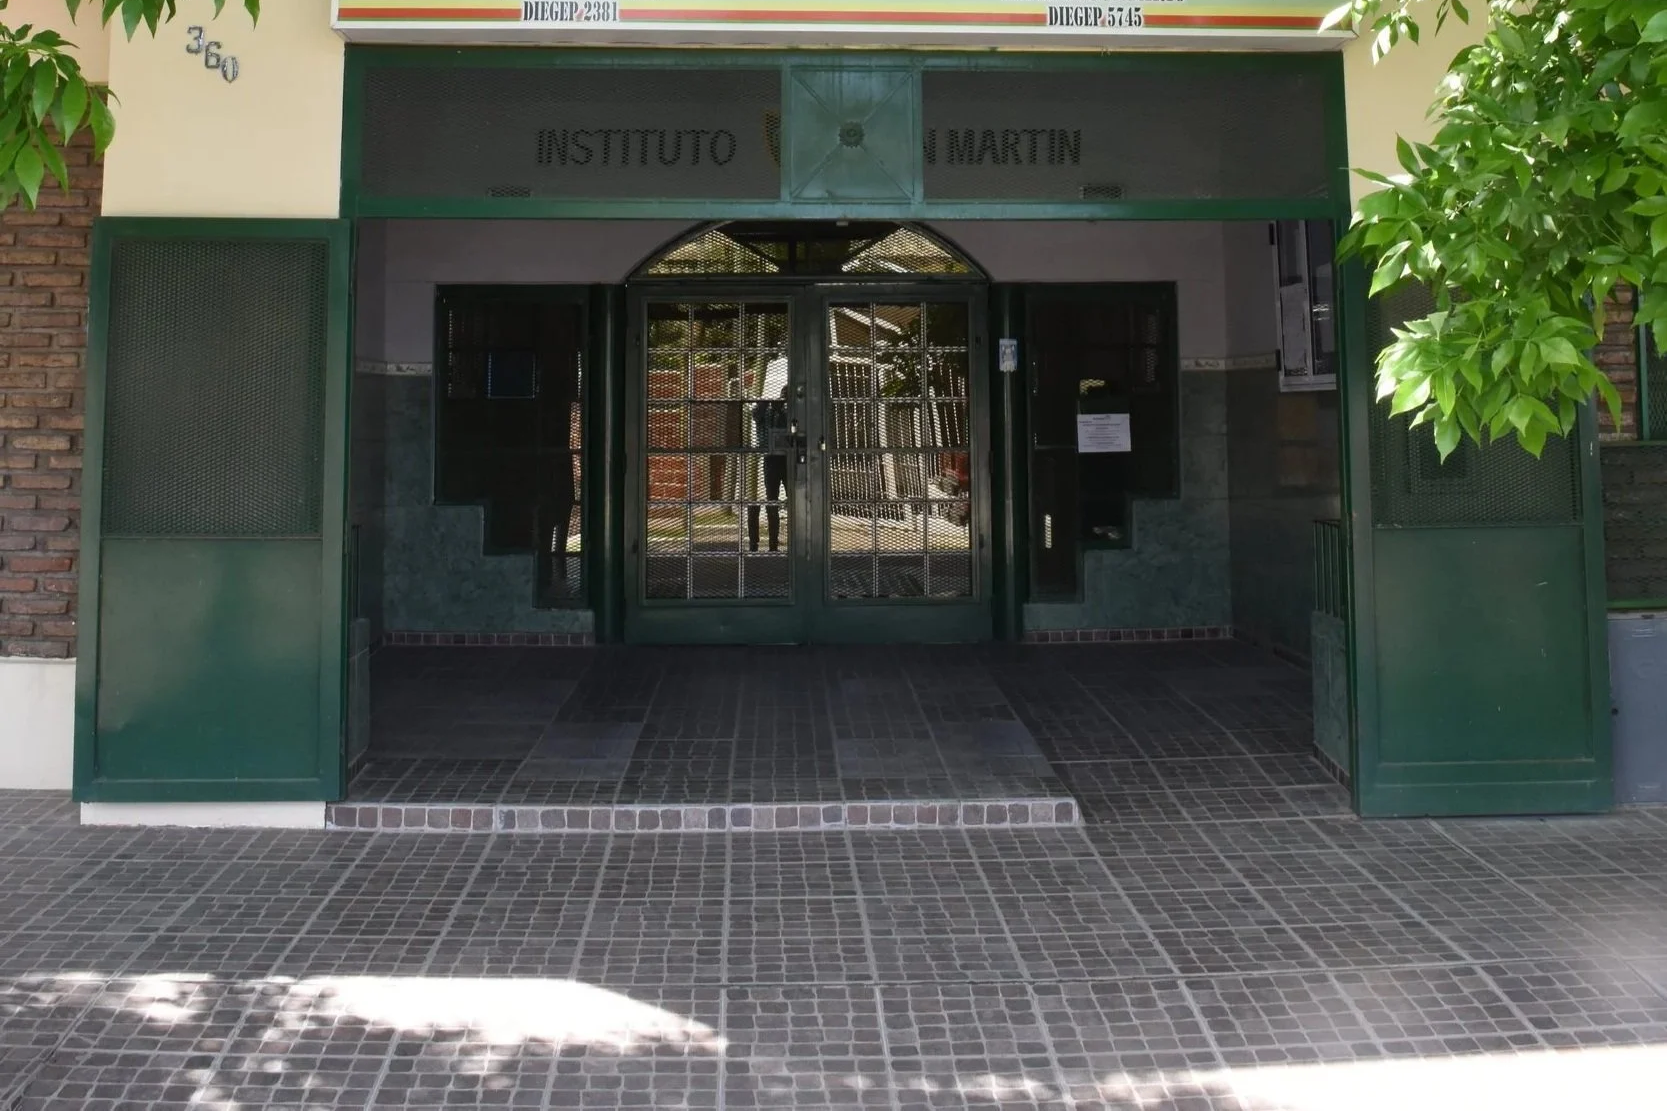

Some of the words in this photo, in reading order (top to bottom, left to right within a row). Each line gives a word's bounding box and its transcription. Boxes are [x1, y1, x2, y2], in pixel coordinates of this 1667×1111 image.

[523, 1, 578, 21] DIEGEP
[583, 1, 618, 21] 2381
[1048, 6, 1102, 26] DIEGEP
[1107, 7, 1142, 27] 5745
[186, 26, 239, 82] 360
[536, 128, 737, 166] INSTITUTO
[946, 128, 1081, 165] MARTIN
